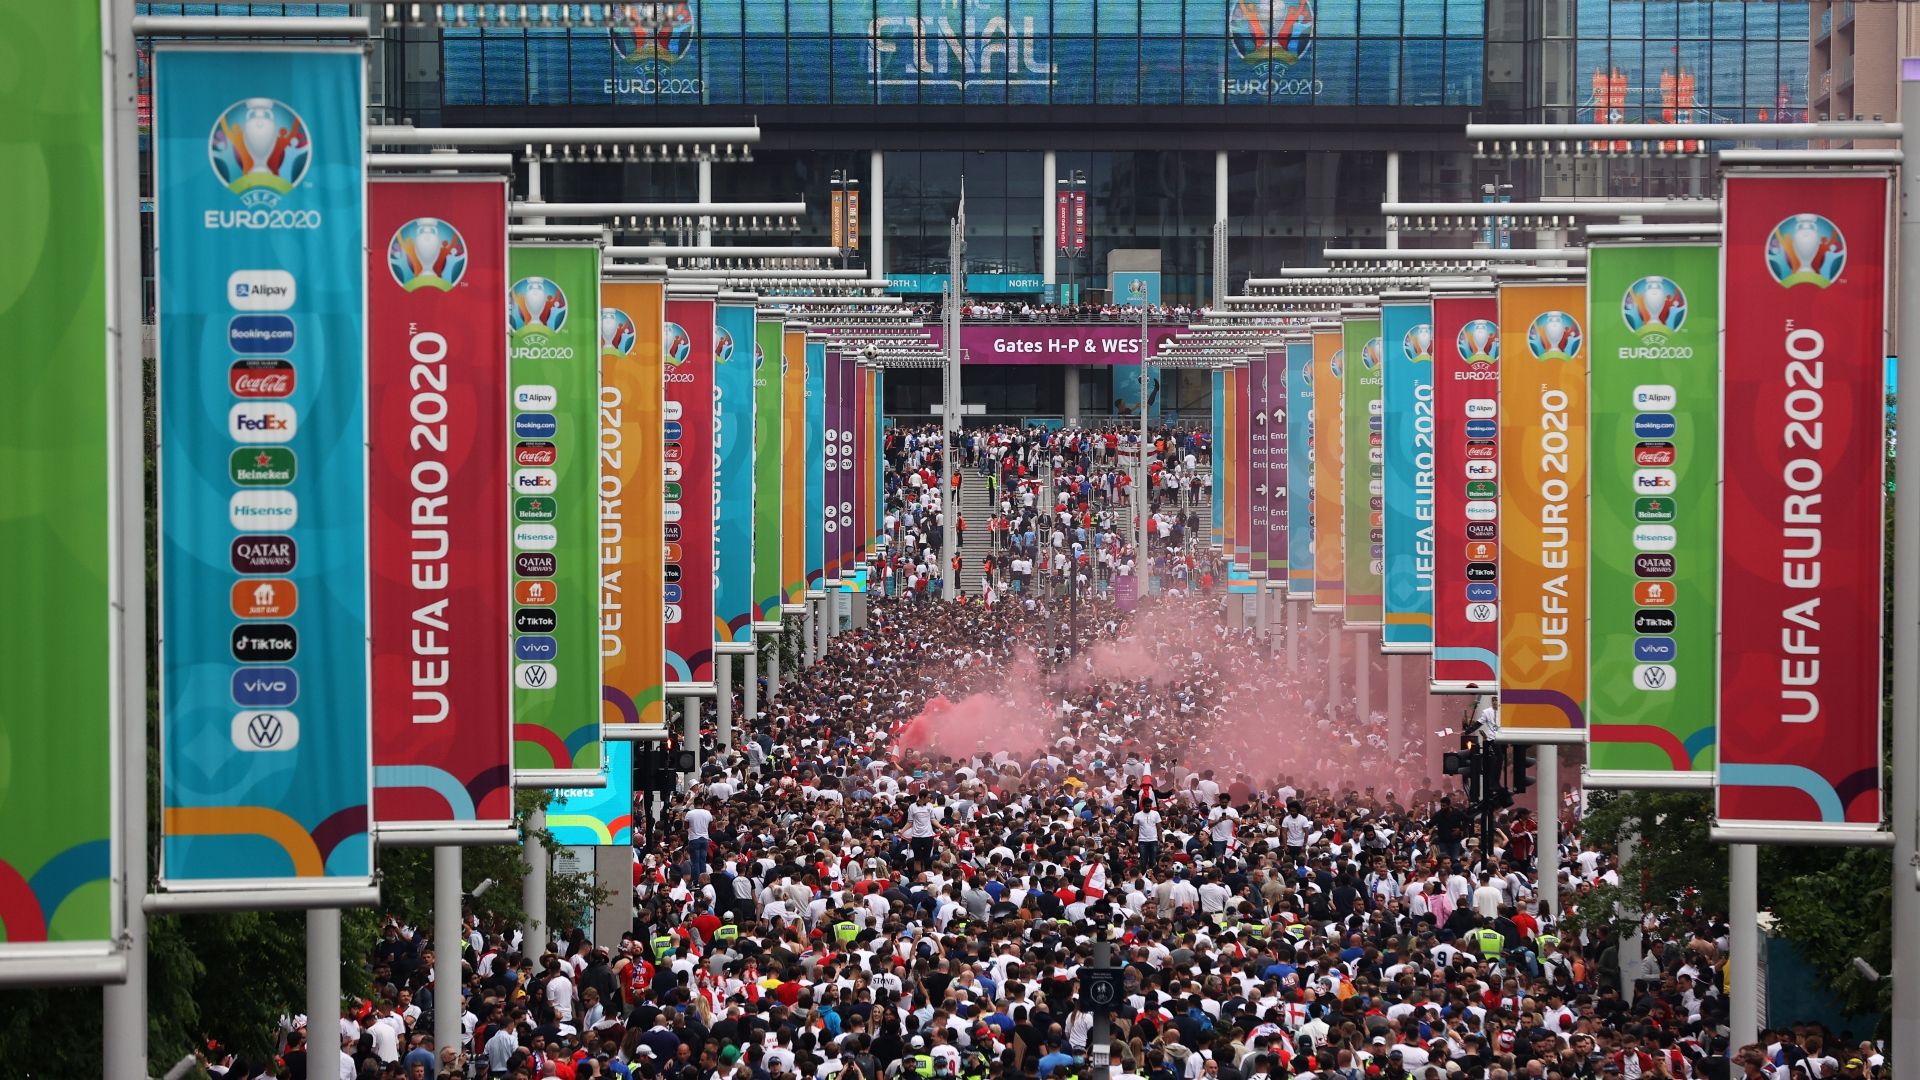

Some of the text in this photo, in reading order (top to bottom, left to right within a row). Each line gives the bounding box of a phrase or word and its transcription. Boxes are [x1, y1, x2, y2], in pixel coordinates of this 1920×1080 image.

[867, 16, 1058, 73] FINAL
[603, 79, 704, 94] EURO2020
[1222, 79, 1323, 95] EURO2020
[204, 209, 322, 229] EURO2020
[251, 284, 288, 296] Alipay
[231, 328, 293, 340] Booking.com
[510, 347, 574, 359] URO2020
[994, 338, 1042, 353] Gates
[1048, 338, 1080, 352] H-P
[1084, 338, 1096, 352] &
[1618, 346, 1693, 359] EURO2020
[1454, 372, 1500, 380] EURO20
[409, 331, 448, 452] 2020
[1784, 328, 1824, 450] 2020
[528, 394, 552, 402] Alipay
[1648, 394, 1671, 402] Alipay
[237, 414, 288, 430] FedEx
[1414, 384, 1432, 448] 2020
[516, 422, 555, 430] Booking.com
[1541, 389, 1569, 474] 2020
[237, 468, 290, 480] Heineken
[1469, 466, 1493, 474] FedEx
[520, 476, 551, 486] FedEx
[1416, 452, 1434, 520] EURO
[1638, 476, 1670, 487] FedEx
[234, 505, 292, 516] Hisense
[520, 510, 552, 518] Heineken
[410, 460, 449, 590] EURO
[600, 386, 622, 657] UEFA EURO 2020
[1542, 478, 1568, 569] EURO
[1782, 458, 1823, 588] EURO
[237, 543, 290, 558] QATAR
[250, 558, 291, 566] AIRWAYS
[519, 557, 552, 568] QATAR
[1416, 525, 1434, 592] UEFA
[1638, 558, 1672, 568] QATAR
[1542, 574, 1569, 662] UEFA
[250, 638, 292, 650] TikTok
[522, 644, 550, 652] vivo
[412, 598, 450, 724] UEFA
[1780, 597, 1820, 723] UEFA
[244, 680, 286, 692] vivo
[1437, 951, 1447, 967] 9
